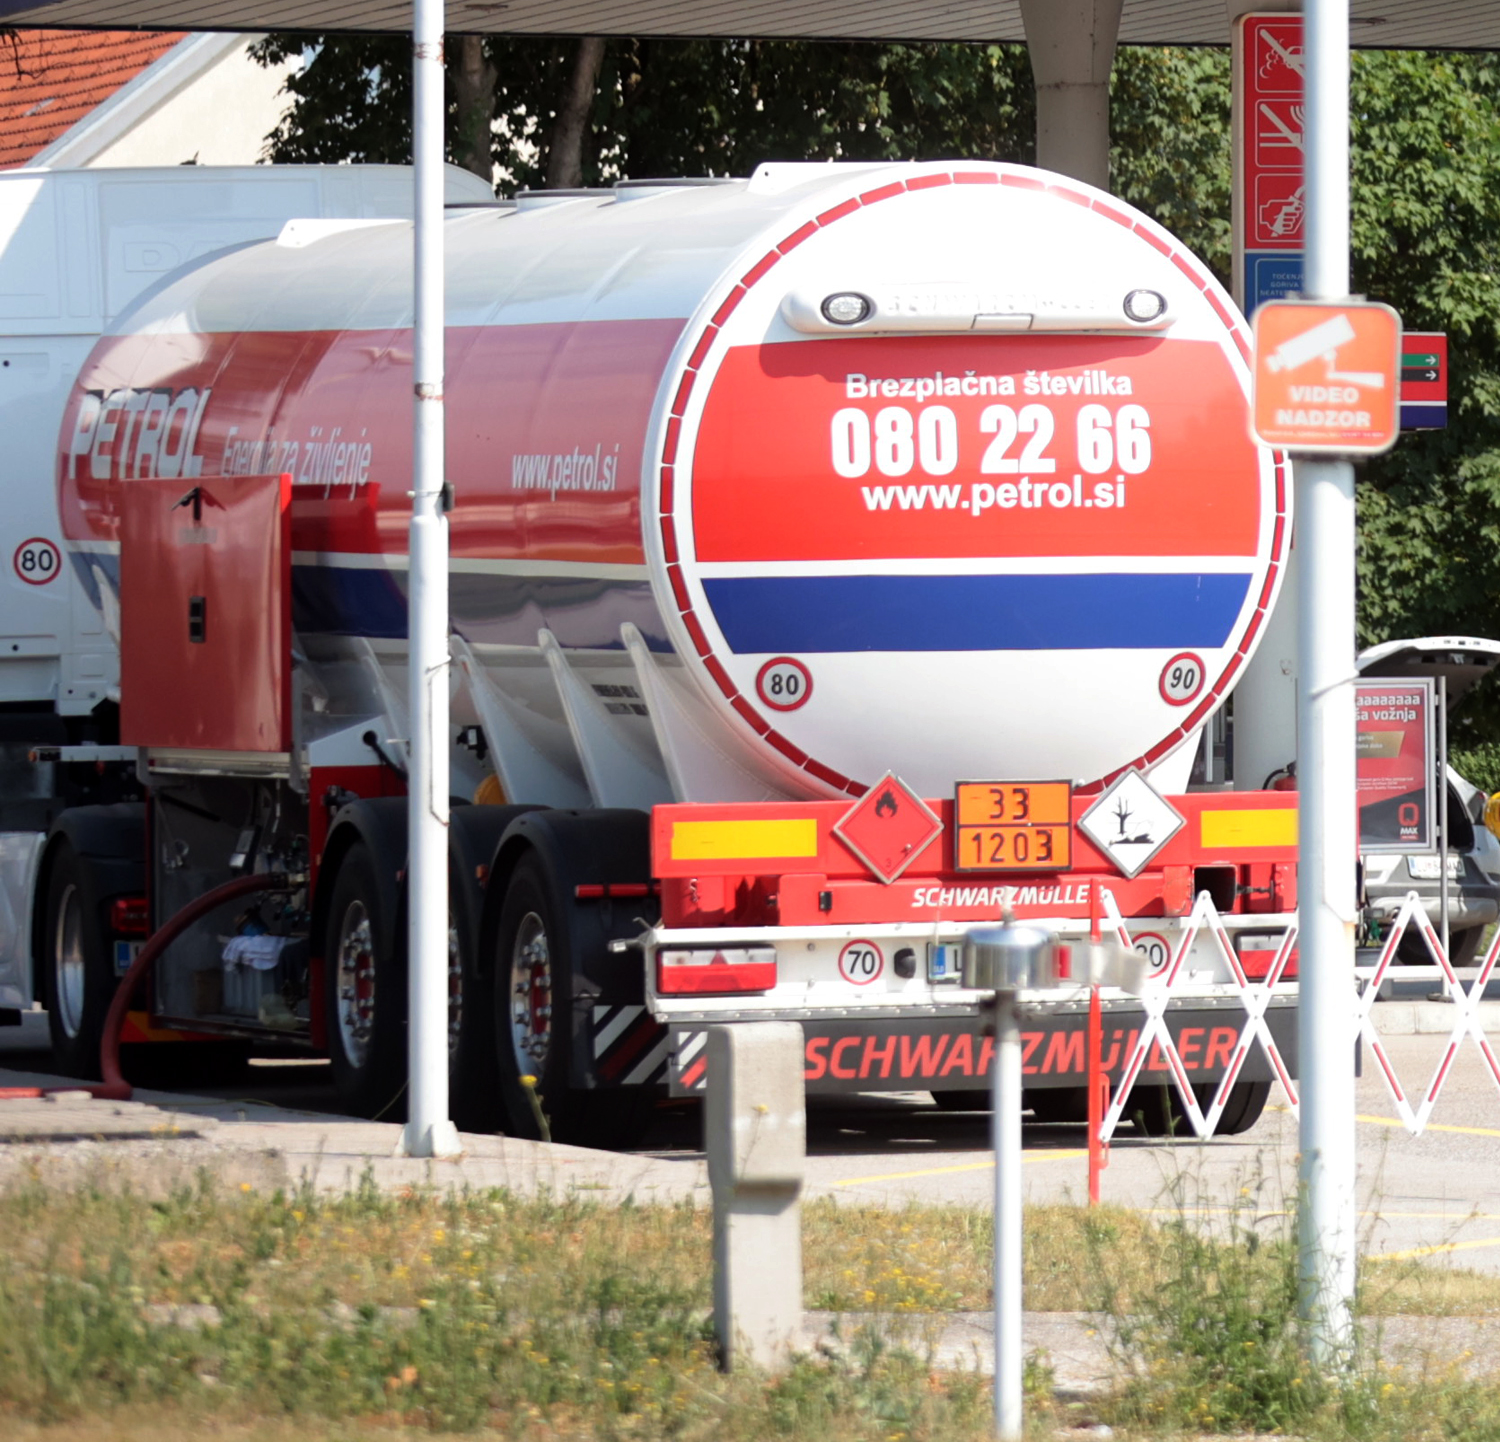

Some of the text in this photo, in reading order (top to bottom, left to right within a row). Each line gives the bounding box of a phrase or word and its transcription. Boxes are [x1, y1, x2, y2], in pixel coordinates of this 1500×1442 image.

[845, 370, 1133, 399] Brezplačna številka
[1289, 385, 1360, 403] VIDEO
[1276, 409, 1371, 428] NADZOR
[69, 385, 213, 480] PETROL
[830, 403, 1152, 479] 080 22 66
[299, 425, 373, 501] življenje
[512, 442, 620, 502] www.petrol.si
[861, 475, 1127, 516] www.petrol.si
[20, 550, 54, 572] 80
[771, 673, 800, 697] 80
[1169, 667, 1196, 690] 90
[1372, 707, 1417, 722] vožnja
[988, 787, 1030, 821] 33
[1400, 827, 1419, 835] MAX
[972, 828, 1054, 864] 1203
[847, 950, 876, 975] 70
